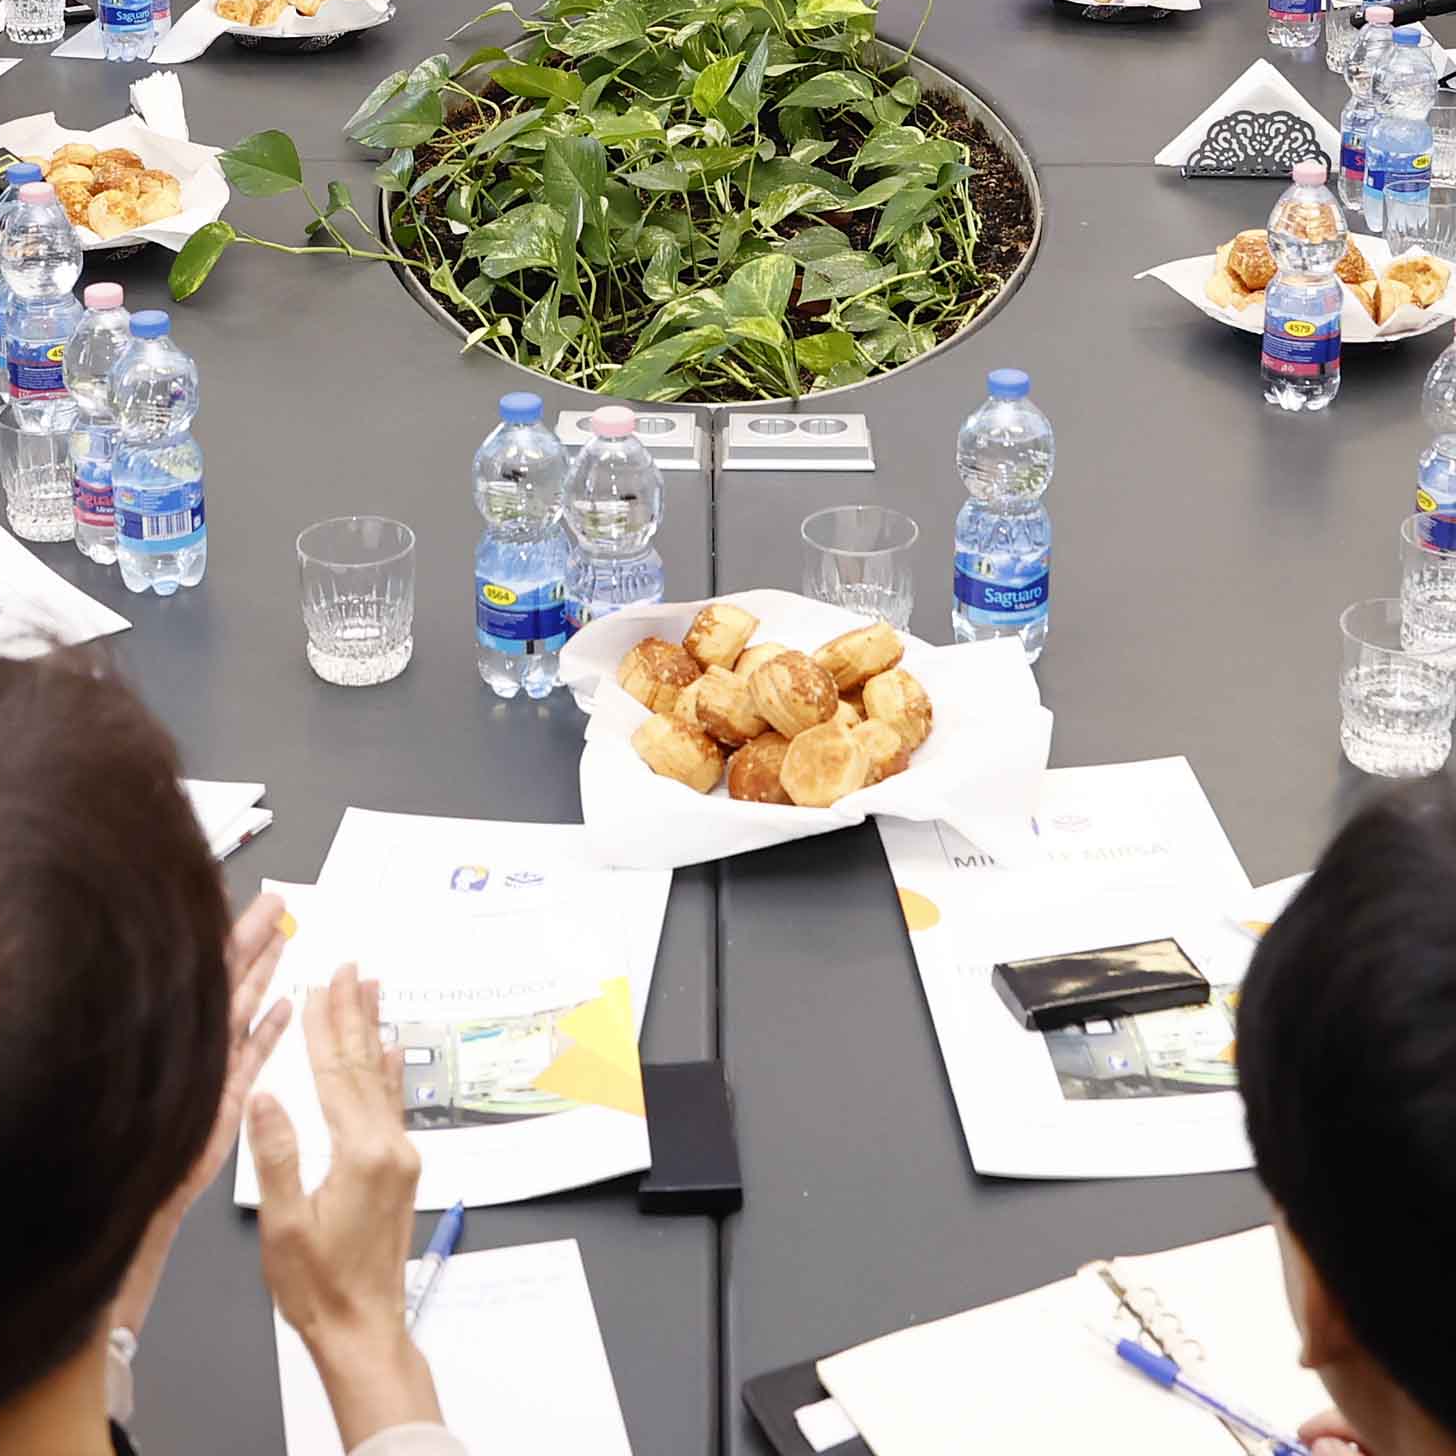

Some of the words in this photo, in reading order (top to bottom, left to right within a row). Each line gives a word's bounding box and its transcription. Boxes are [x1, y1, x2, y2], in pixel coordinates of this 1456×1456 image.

[115, 8, 151, 23] Saguaro
[1289, 323, 1312, 333] 4579
[984, 586, 1042, 608] Saguaro
